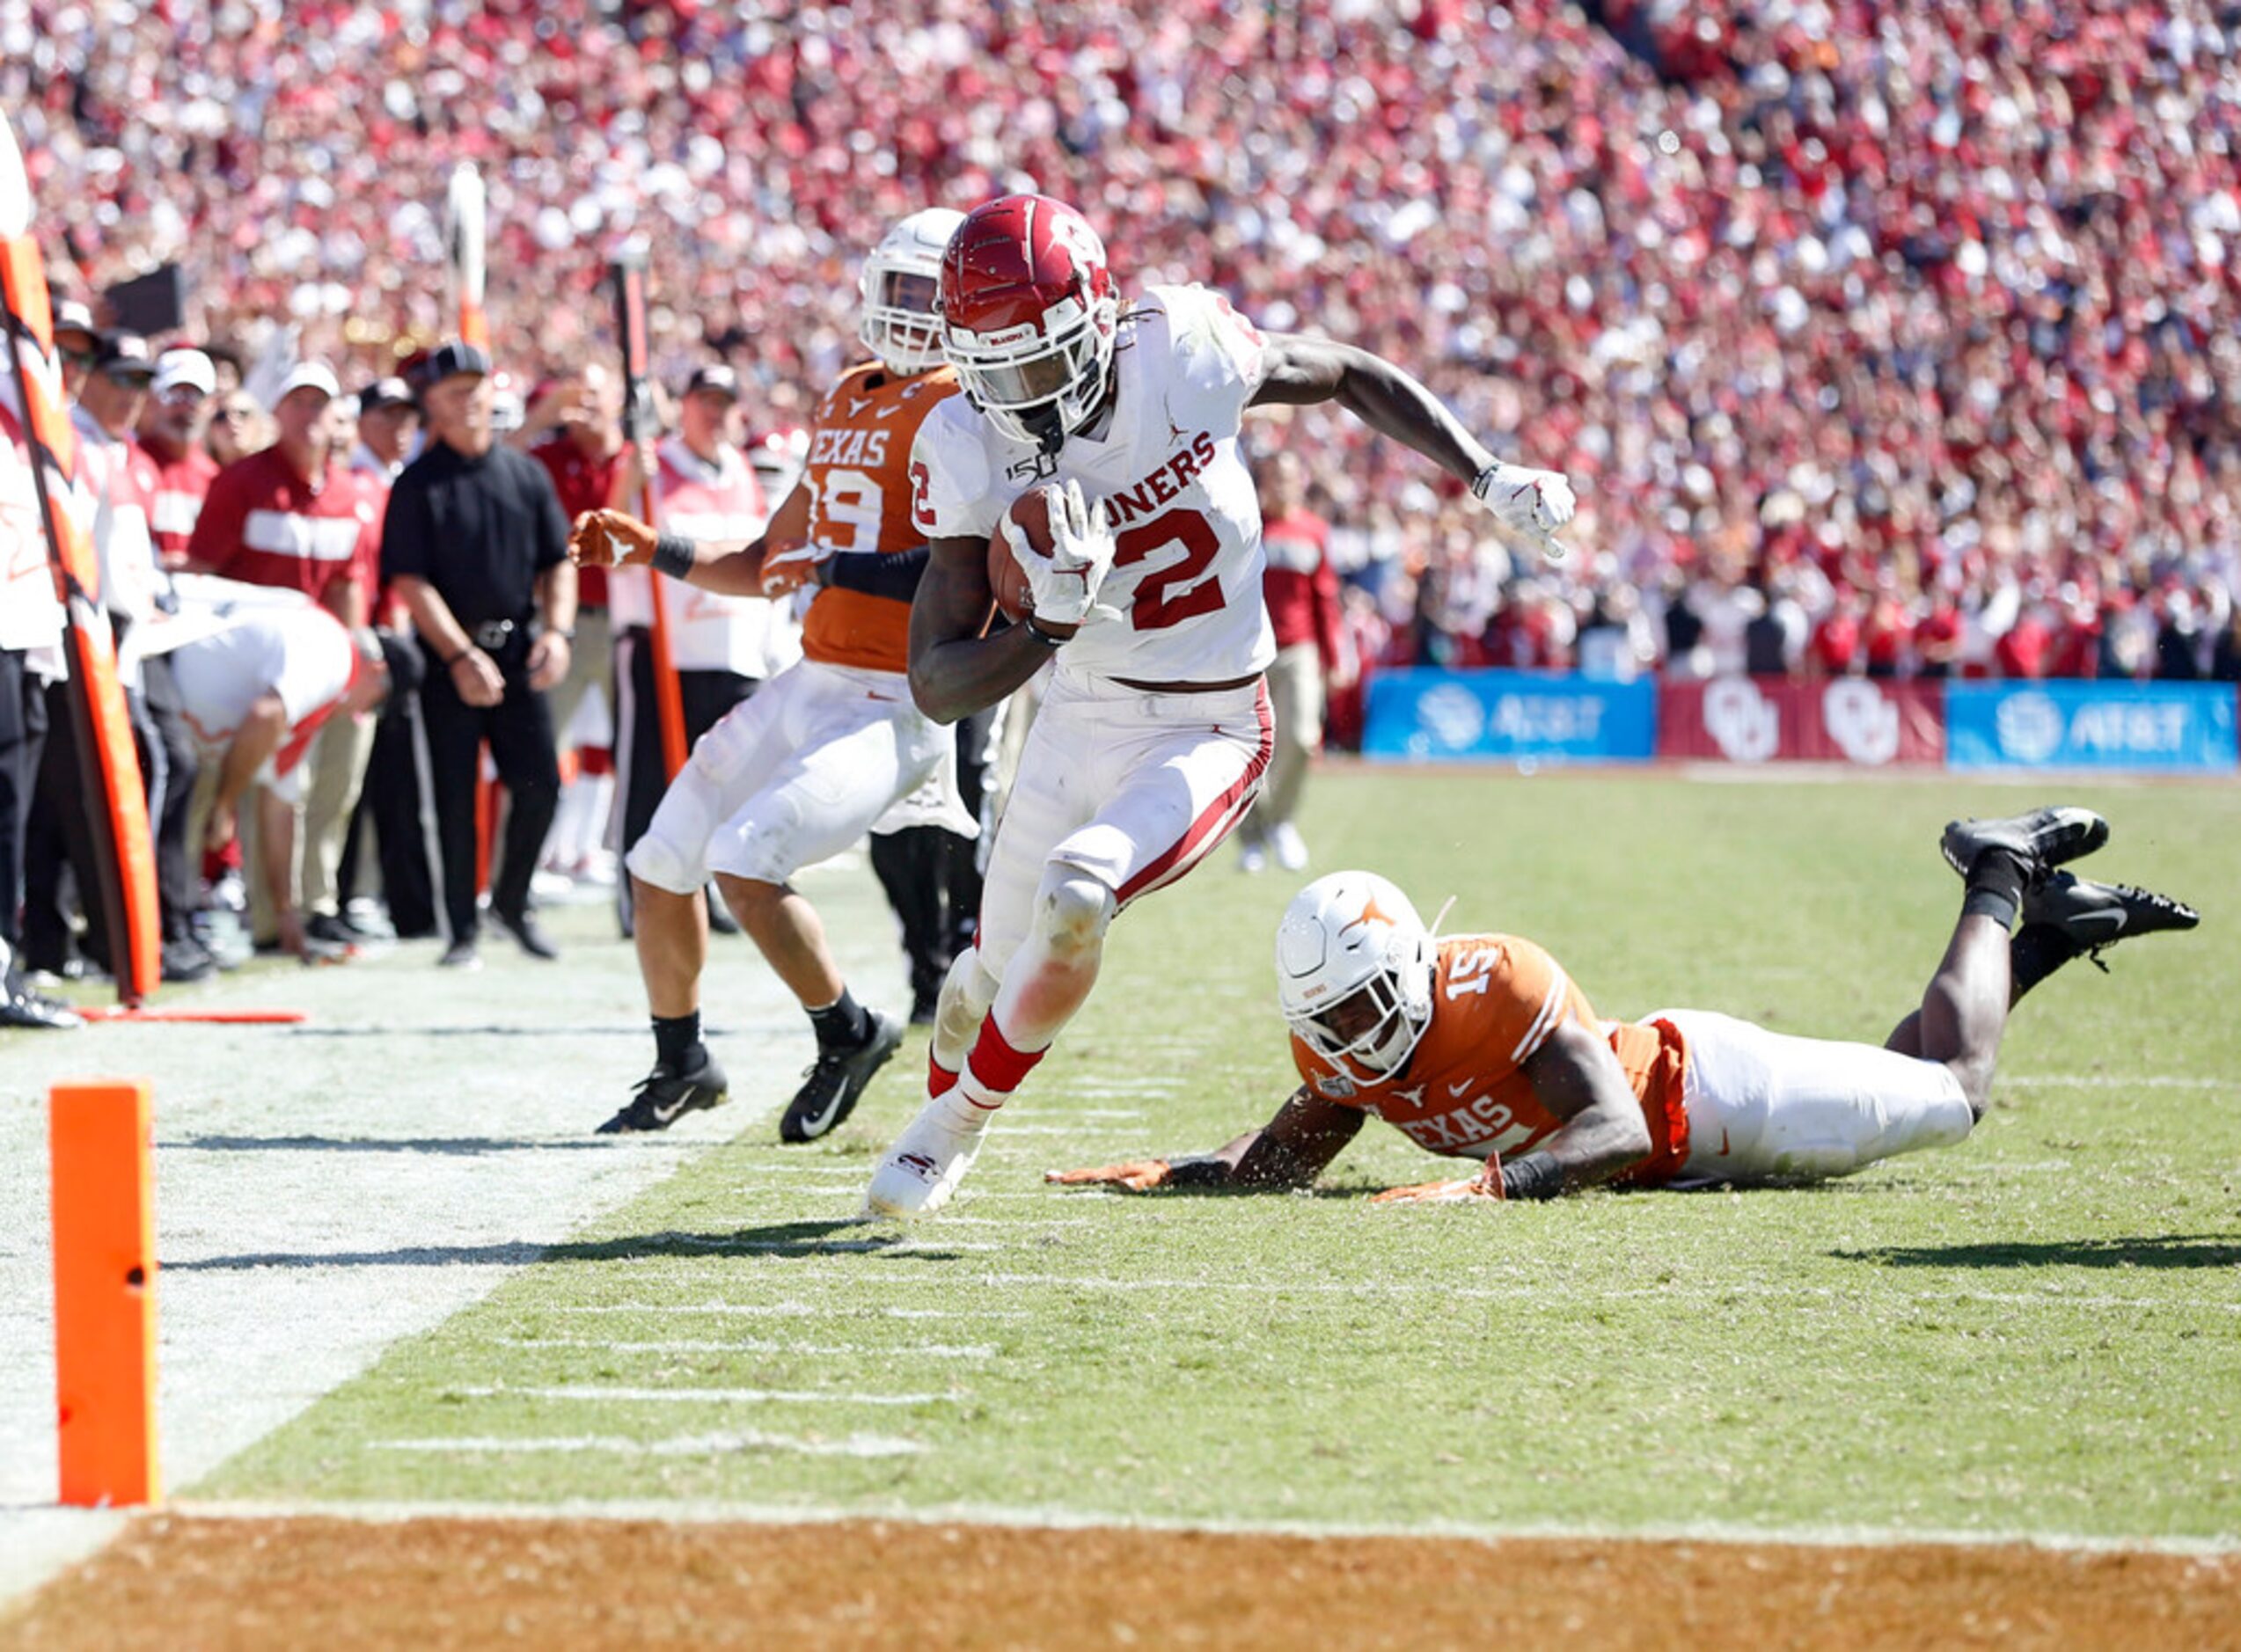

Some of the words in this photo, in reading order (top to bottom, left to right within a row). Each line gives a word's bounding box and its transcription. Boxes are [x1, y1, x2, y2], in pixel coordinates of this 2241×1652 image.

[809, 428, 892, 468] EXAS
[802, 468, 884, 554] 9
[911, 461, 937, 525] 2
[1111, 508, 1227, 632] 2
[1446, 949, 1498, 1002] 15
[1397, 1094, 1514, 1150] EXAS
